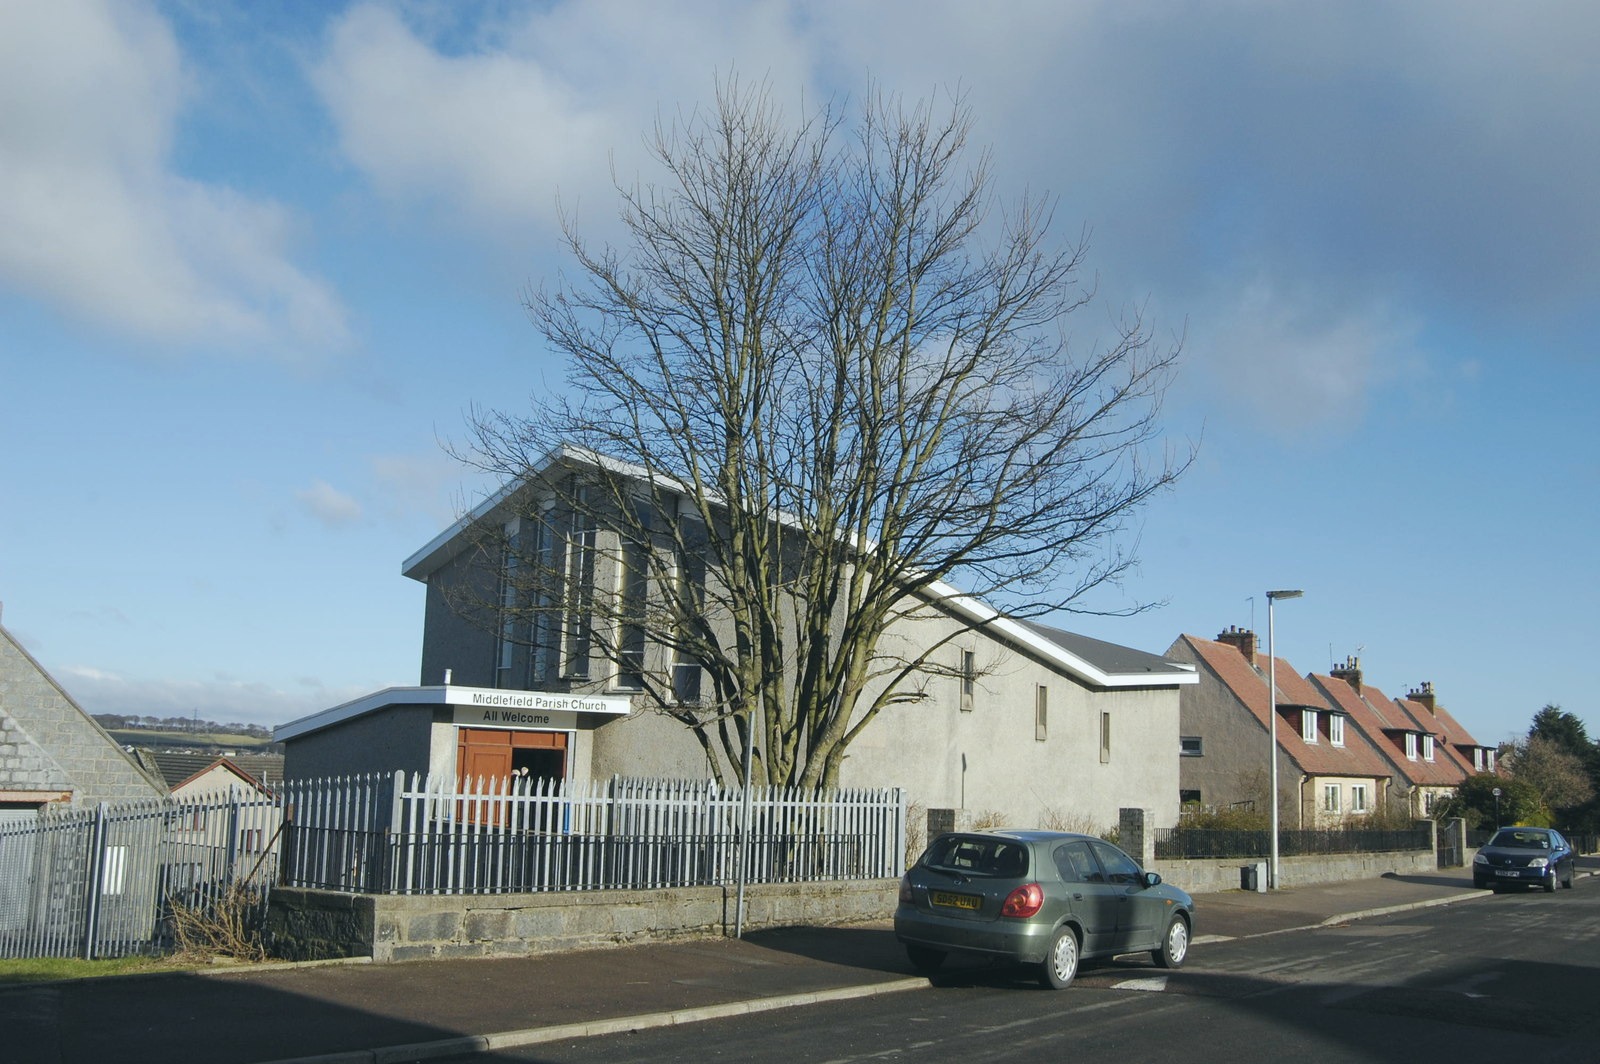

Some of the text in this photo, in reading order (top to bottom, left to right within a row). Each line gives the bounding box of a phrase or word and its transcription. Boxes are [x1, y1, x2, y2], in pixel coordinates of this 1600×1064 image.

[473, 693, 607, 711] Middlefield Parish Church
[483, 710, 550, 724] All Welcome
